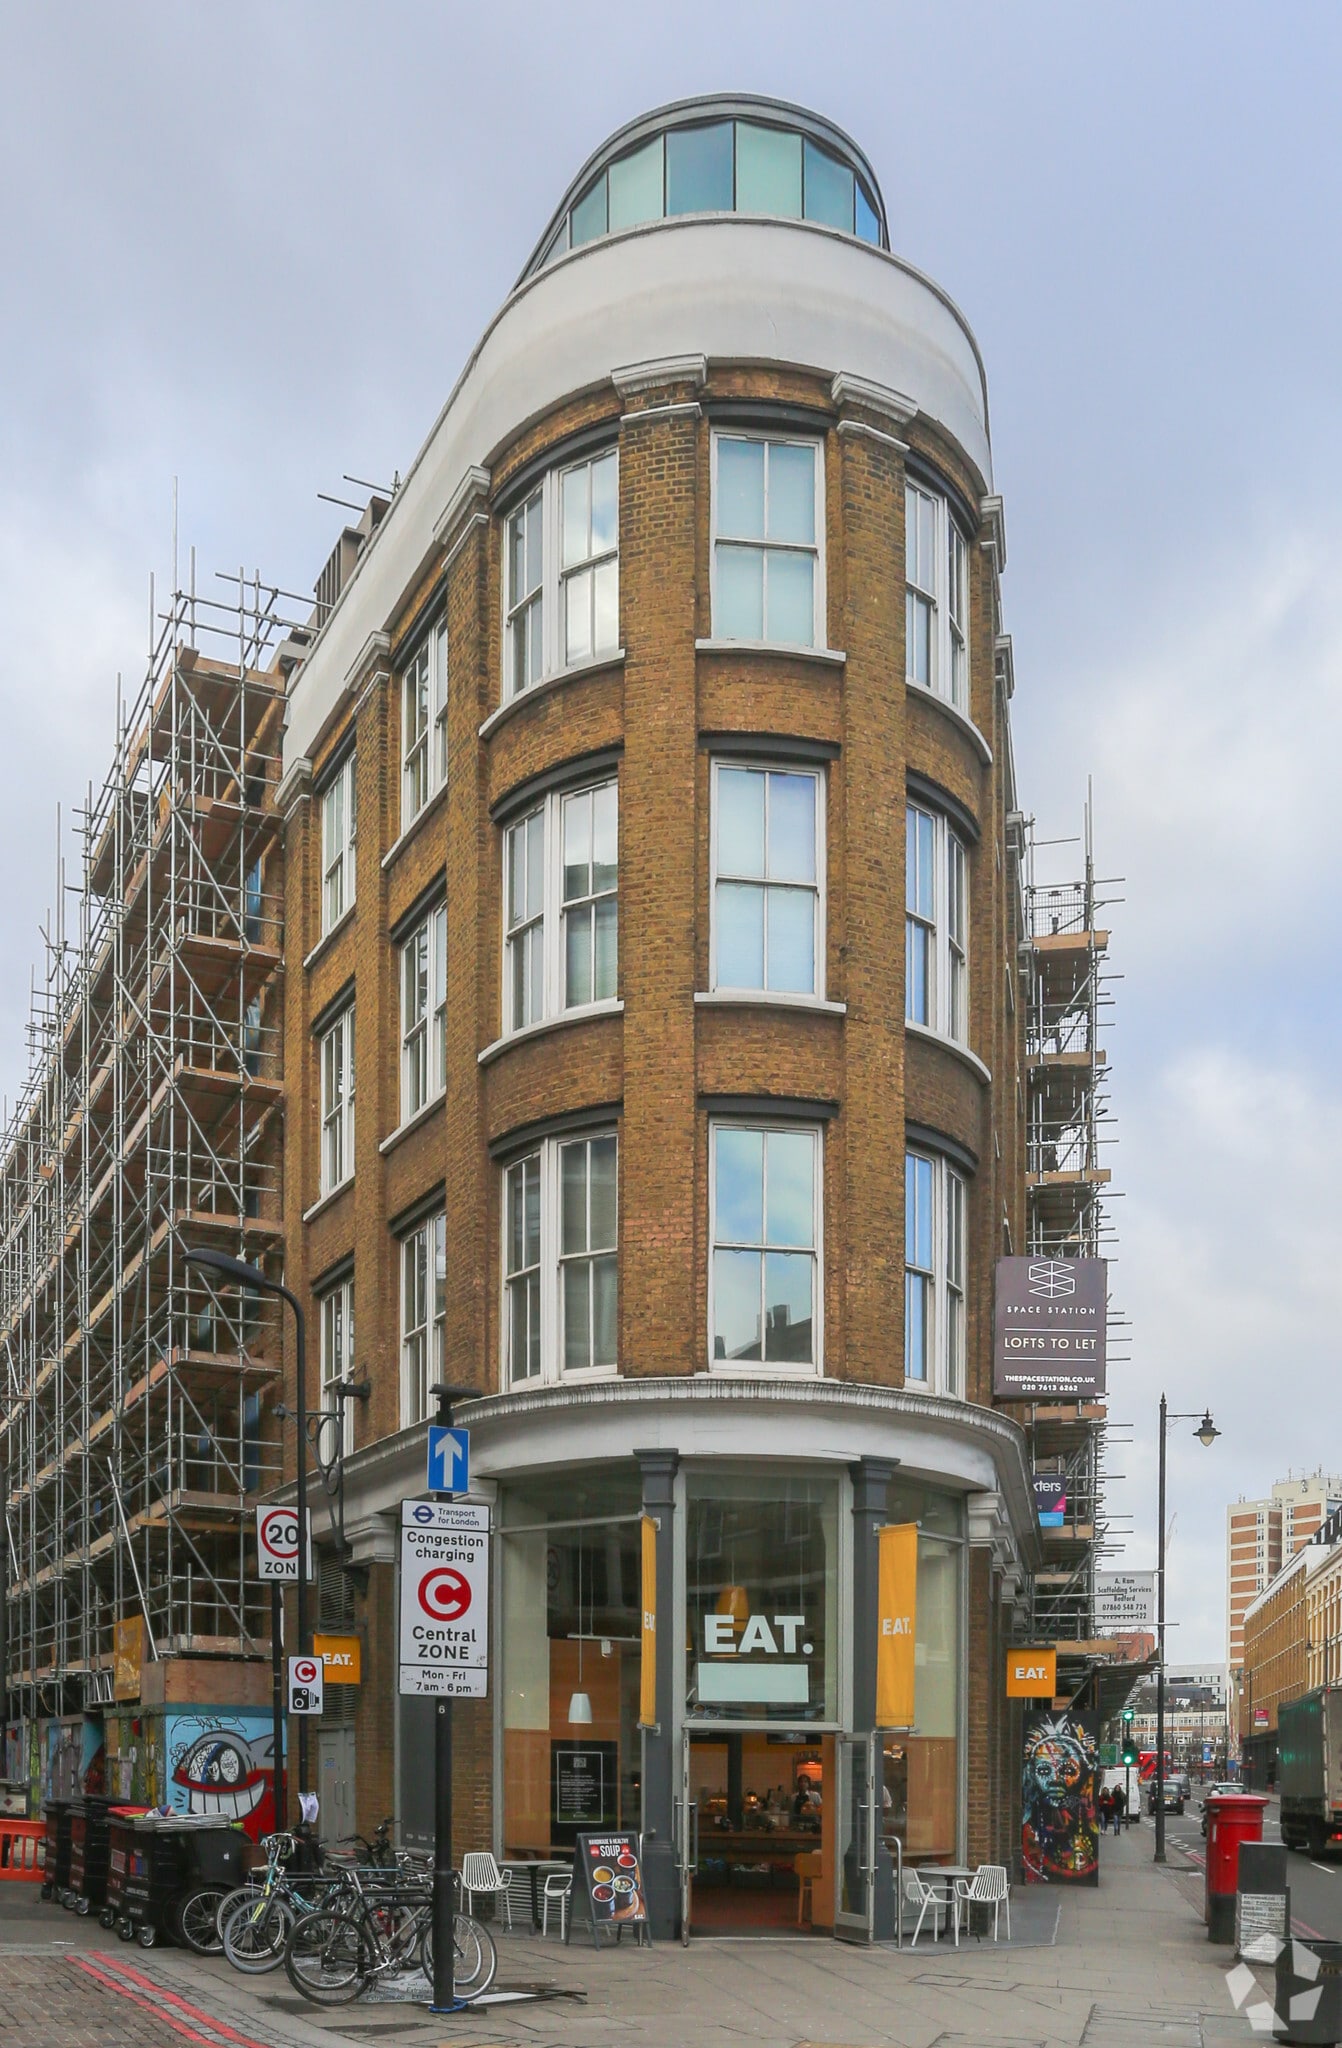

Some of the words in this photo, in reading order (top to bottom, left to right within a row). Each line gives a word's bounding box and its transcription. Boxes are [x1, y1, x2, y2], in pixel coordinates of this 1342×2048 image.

[1006, 1305, 1041, 1314] SPACE
[1047, 1306, 1096, 1315] STATION
[1004, 1337, 1045, 1349] LOFTS
[1050, 1338, 1070, 1349] TO
[1075, 1339, 1097, 1350] LET
[1004, 1375, 1096, 1384] THESPACESTATION.CO.UK
[438, 1507, 476, 1518] Transport
[438, 1517, 449, 1525] for
[451, 1518, 480, 1526] London
[406, 1531, 484, 1547] Congestion
[415, 1547, 474, 1563] charging
[1097, 1586, 1128, 1594] Scaffolding
[882, 1616, 912, 1636] EAT.
[412, 1626, 477, 1642] Central
[705, 1614, 814, 1655] EAT.
[418, 1644, 469, 1659] ZONE
[322, 1652, 354, 1666] EAT.
[421, 1670, 444, 1680] Mon
[452, 1672, 466, 1680] Fri
[1015, 1667, 1048, 1680] EAT.
[438, 1704, 446, 1714] 6
[600, 1844, 621, 1857] SOUP
